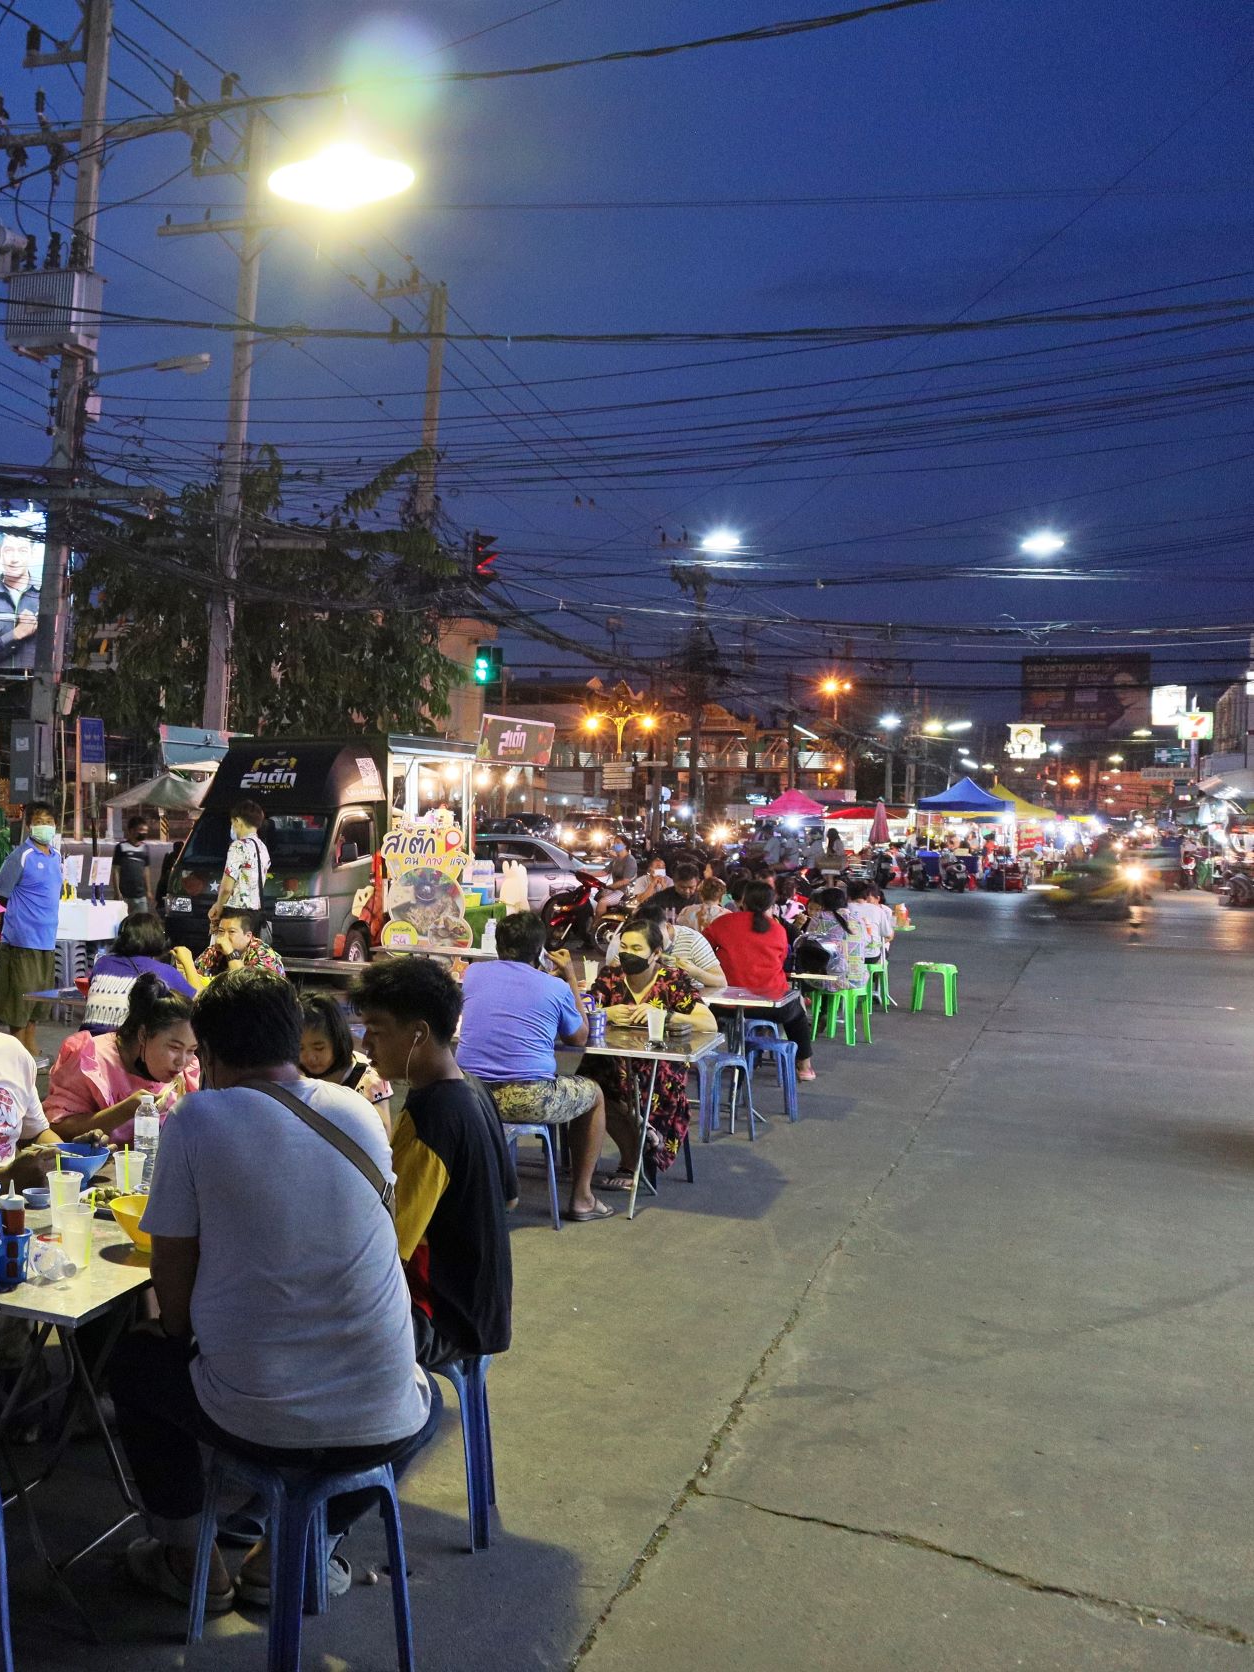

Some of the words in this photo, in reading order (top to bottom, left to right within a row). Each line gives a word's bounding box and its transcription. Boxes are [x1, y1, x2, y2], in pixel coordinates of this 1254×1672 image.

[240, 768, 298, 789] สเต็ก
[384, 829, 436, 855] สเต็ก
[404, 857, 419, 866] คน
[450, 855, 468, 867] แจ้ง
